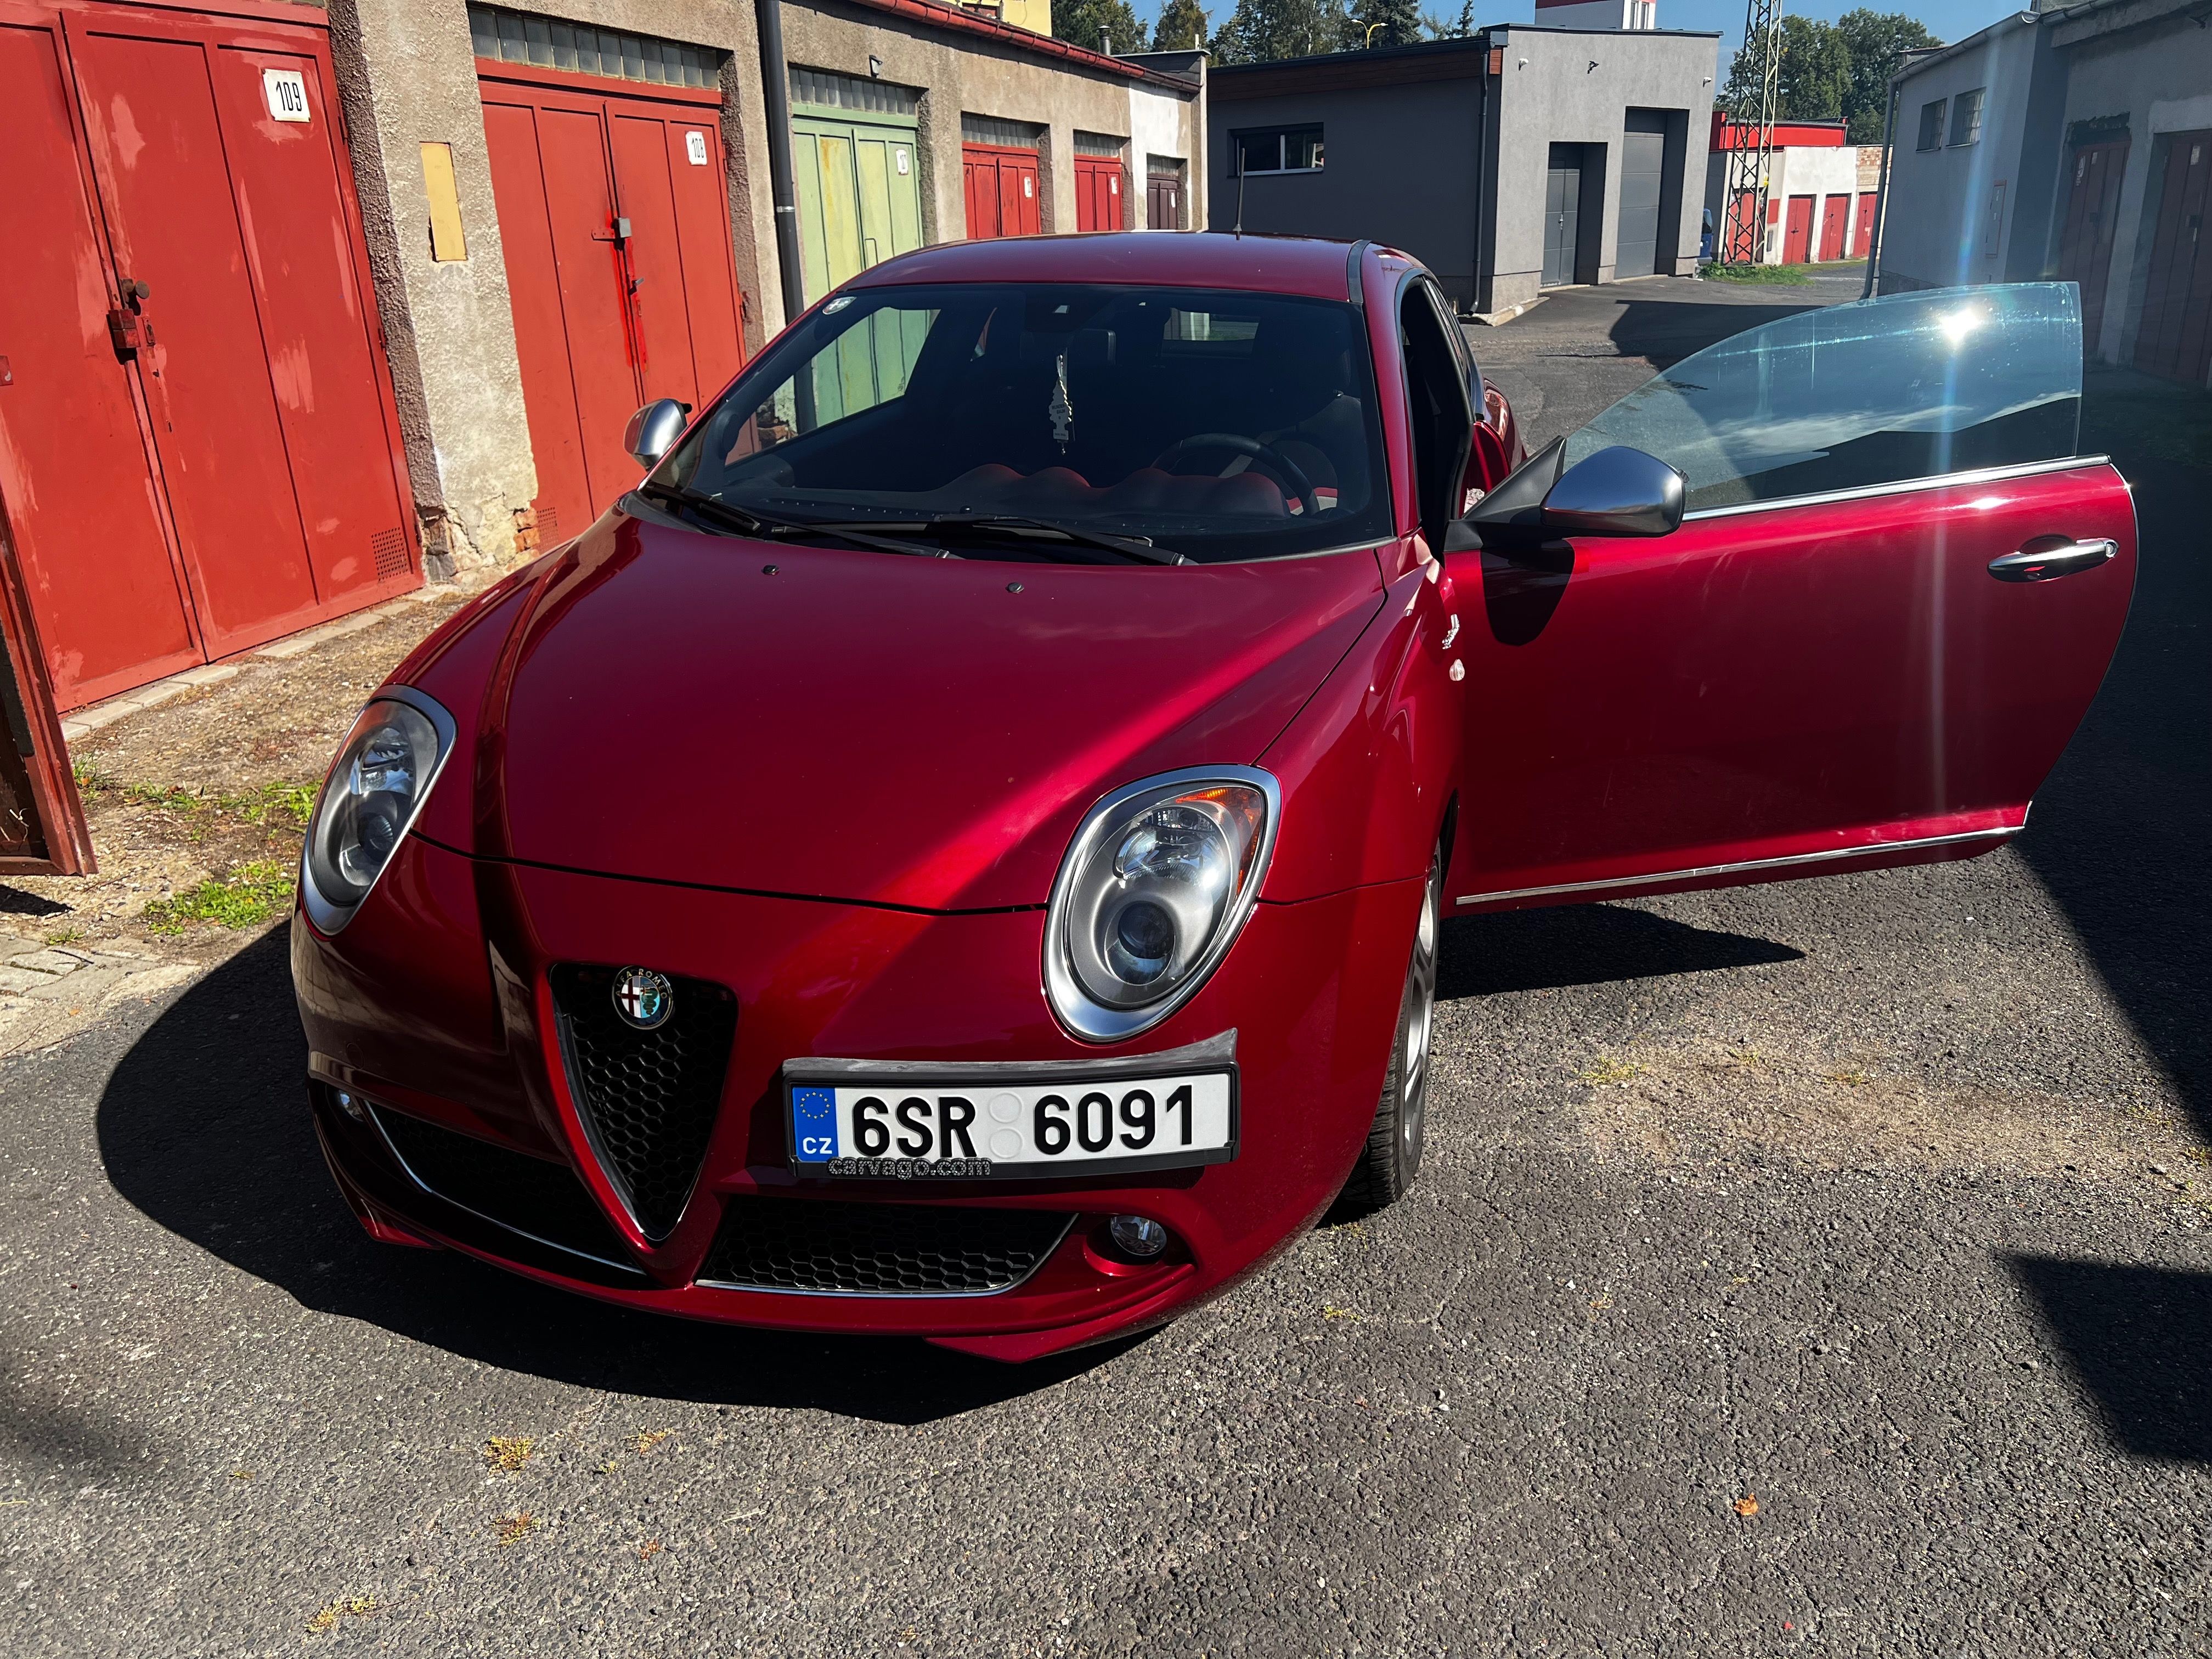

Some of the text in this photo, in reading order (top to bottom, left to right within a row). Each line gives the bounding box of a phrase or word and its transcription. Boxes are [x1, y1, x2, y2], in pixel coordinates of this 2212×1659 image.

[276, 81, 302, 111] 109
[691, 137, 704, 158] 108
[615, 968, 668, 999] ALFA ROMEO
[853, 1084, 1193, 1158] 6SR 6091
[803, 1137, 833, 1154] CZ
[827, 1158, 992, 1180] carvago.com
